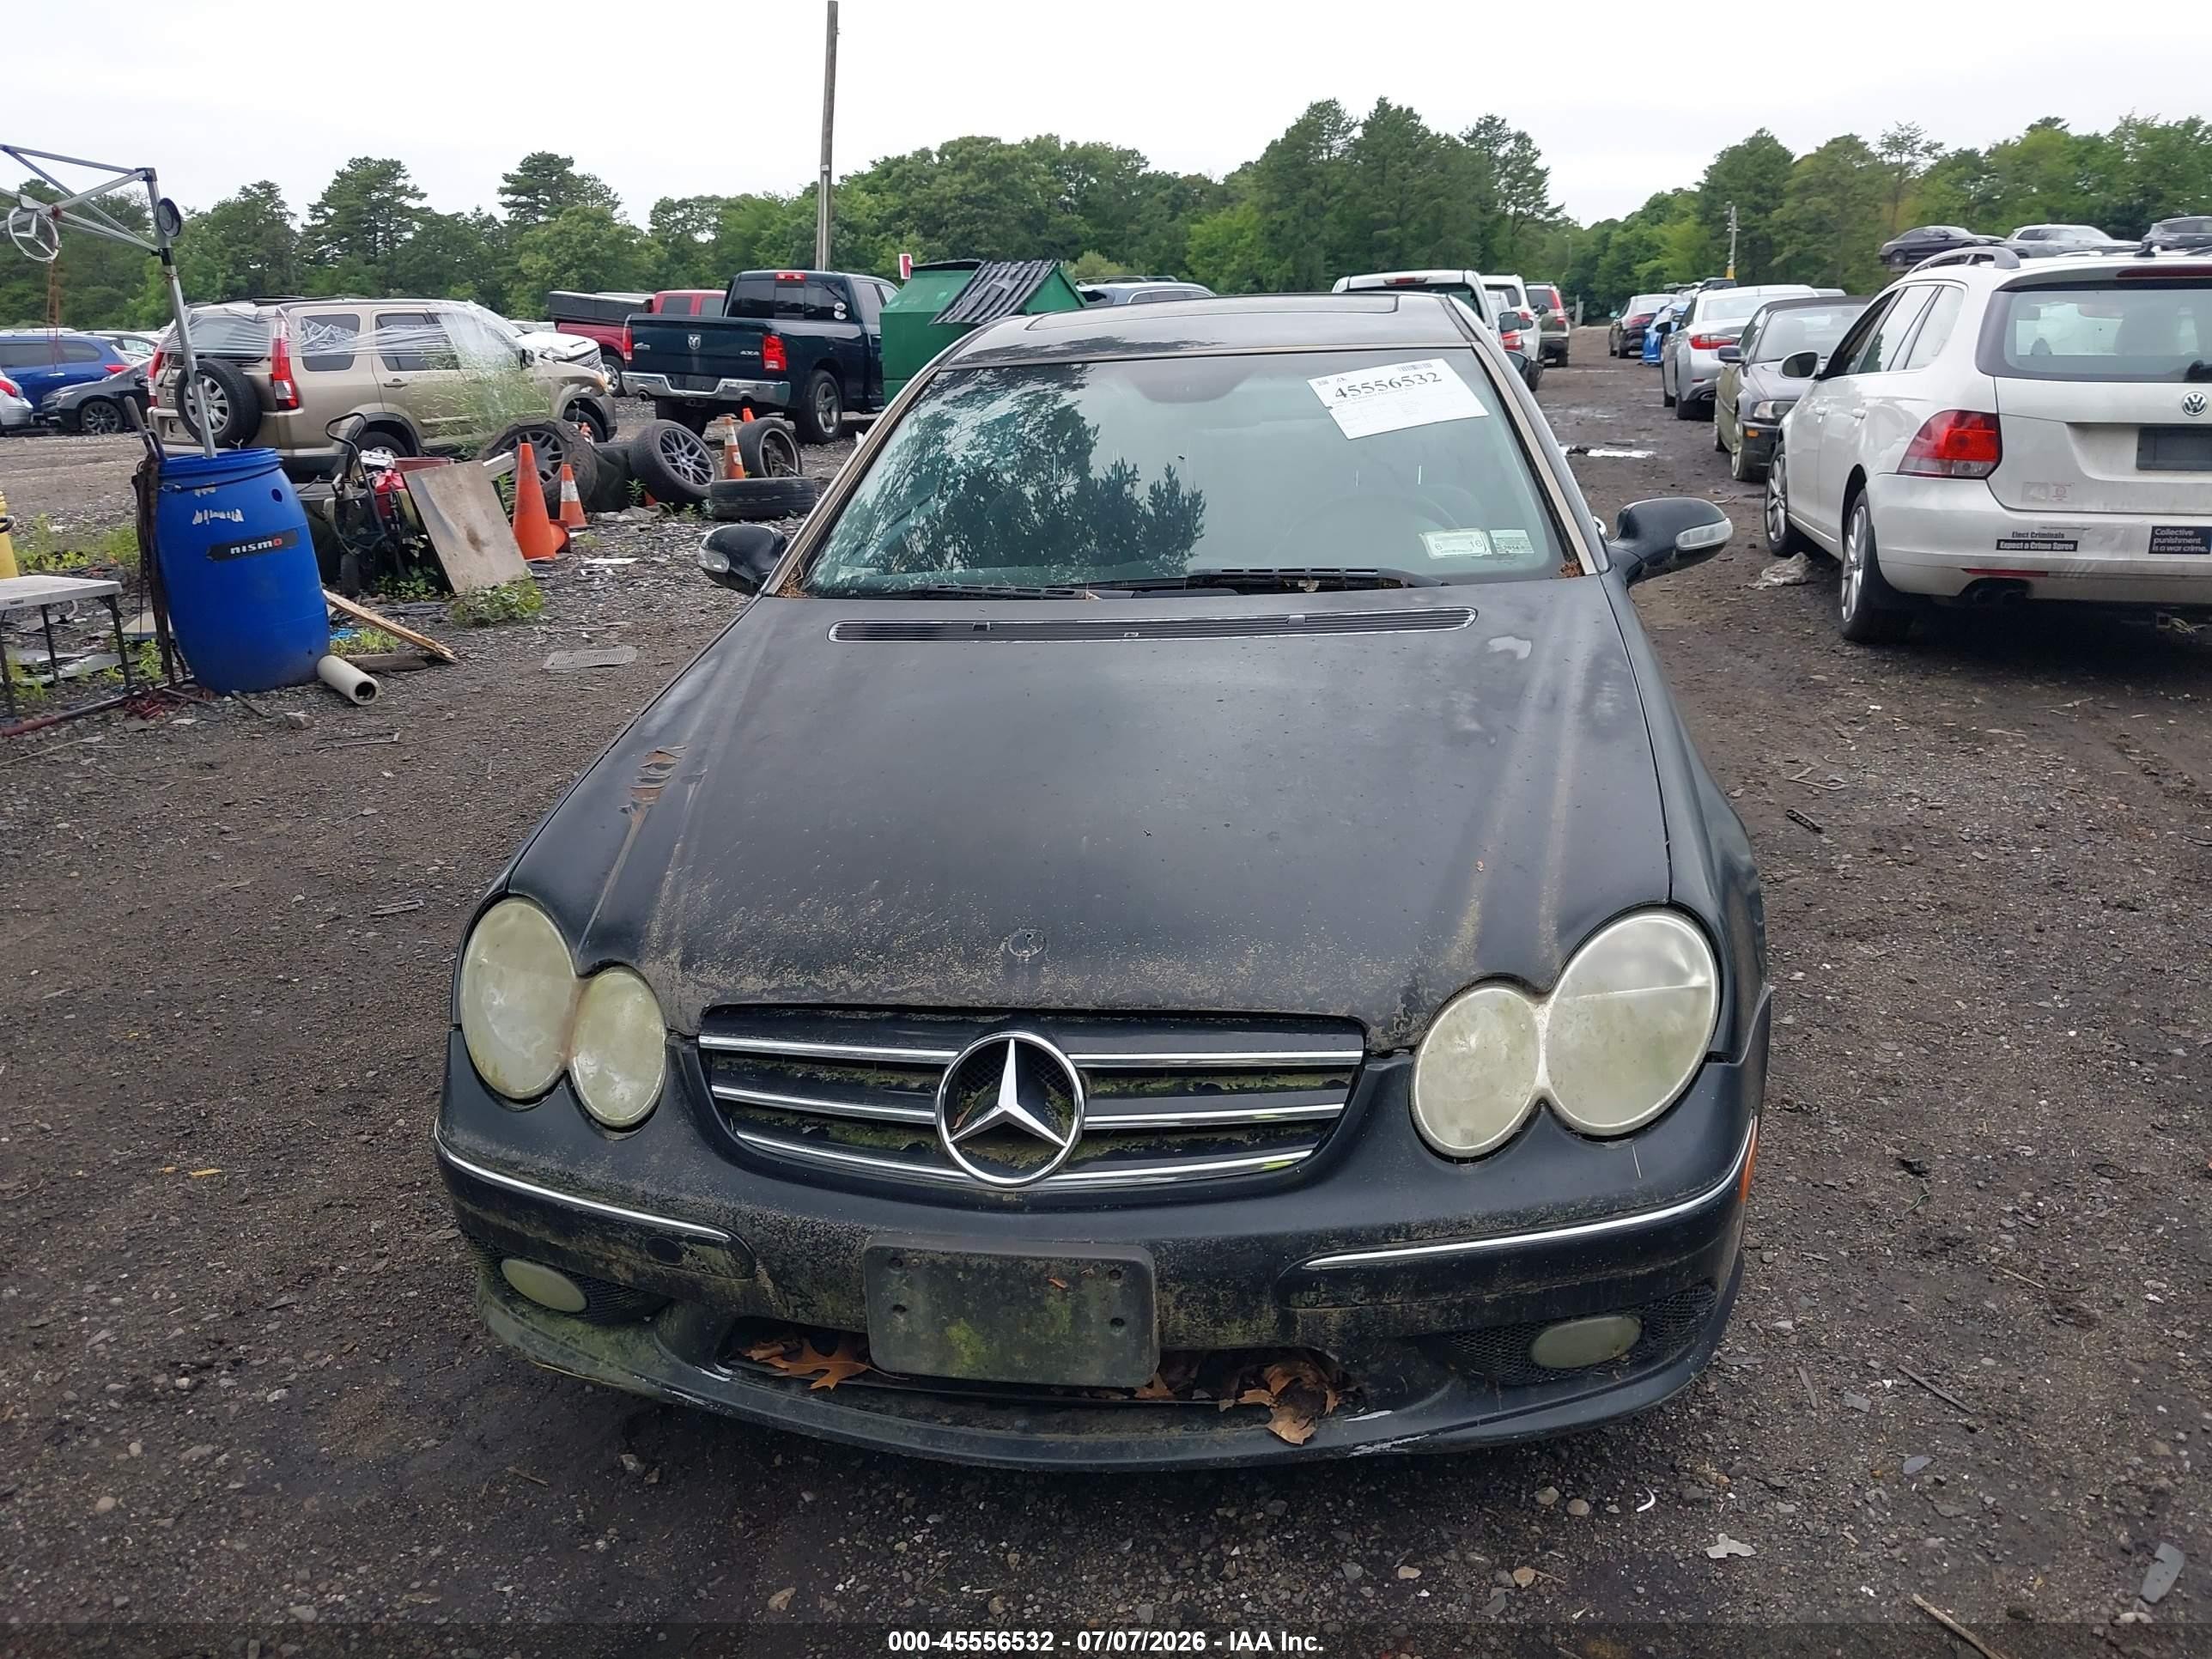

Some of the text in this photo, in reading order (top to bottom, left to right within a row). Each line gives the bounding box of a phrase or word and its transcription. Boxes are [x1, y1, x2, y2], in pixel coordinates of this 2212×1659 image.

[1334, 372, 1443, 398] 45556532
[230, 538, 283, 555] nismo
[2153, 537, 2202, 546] punishment
